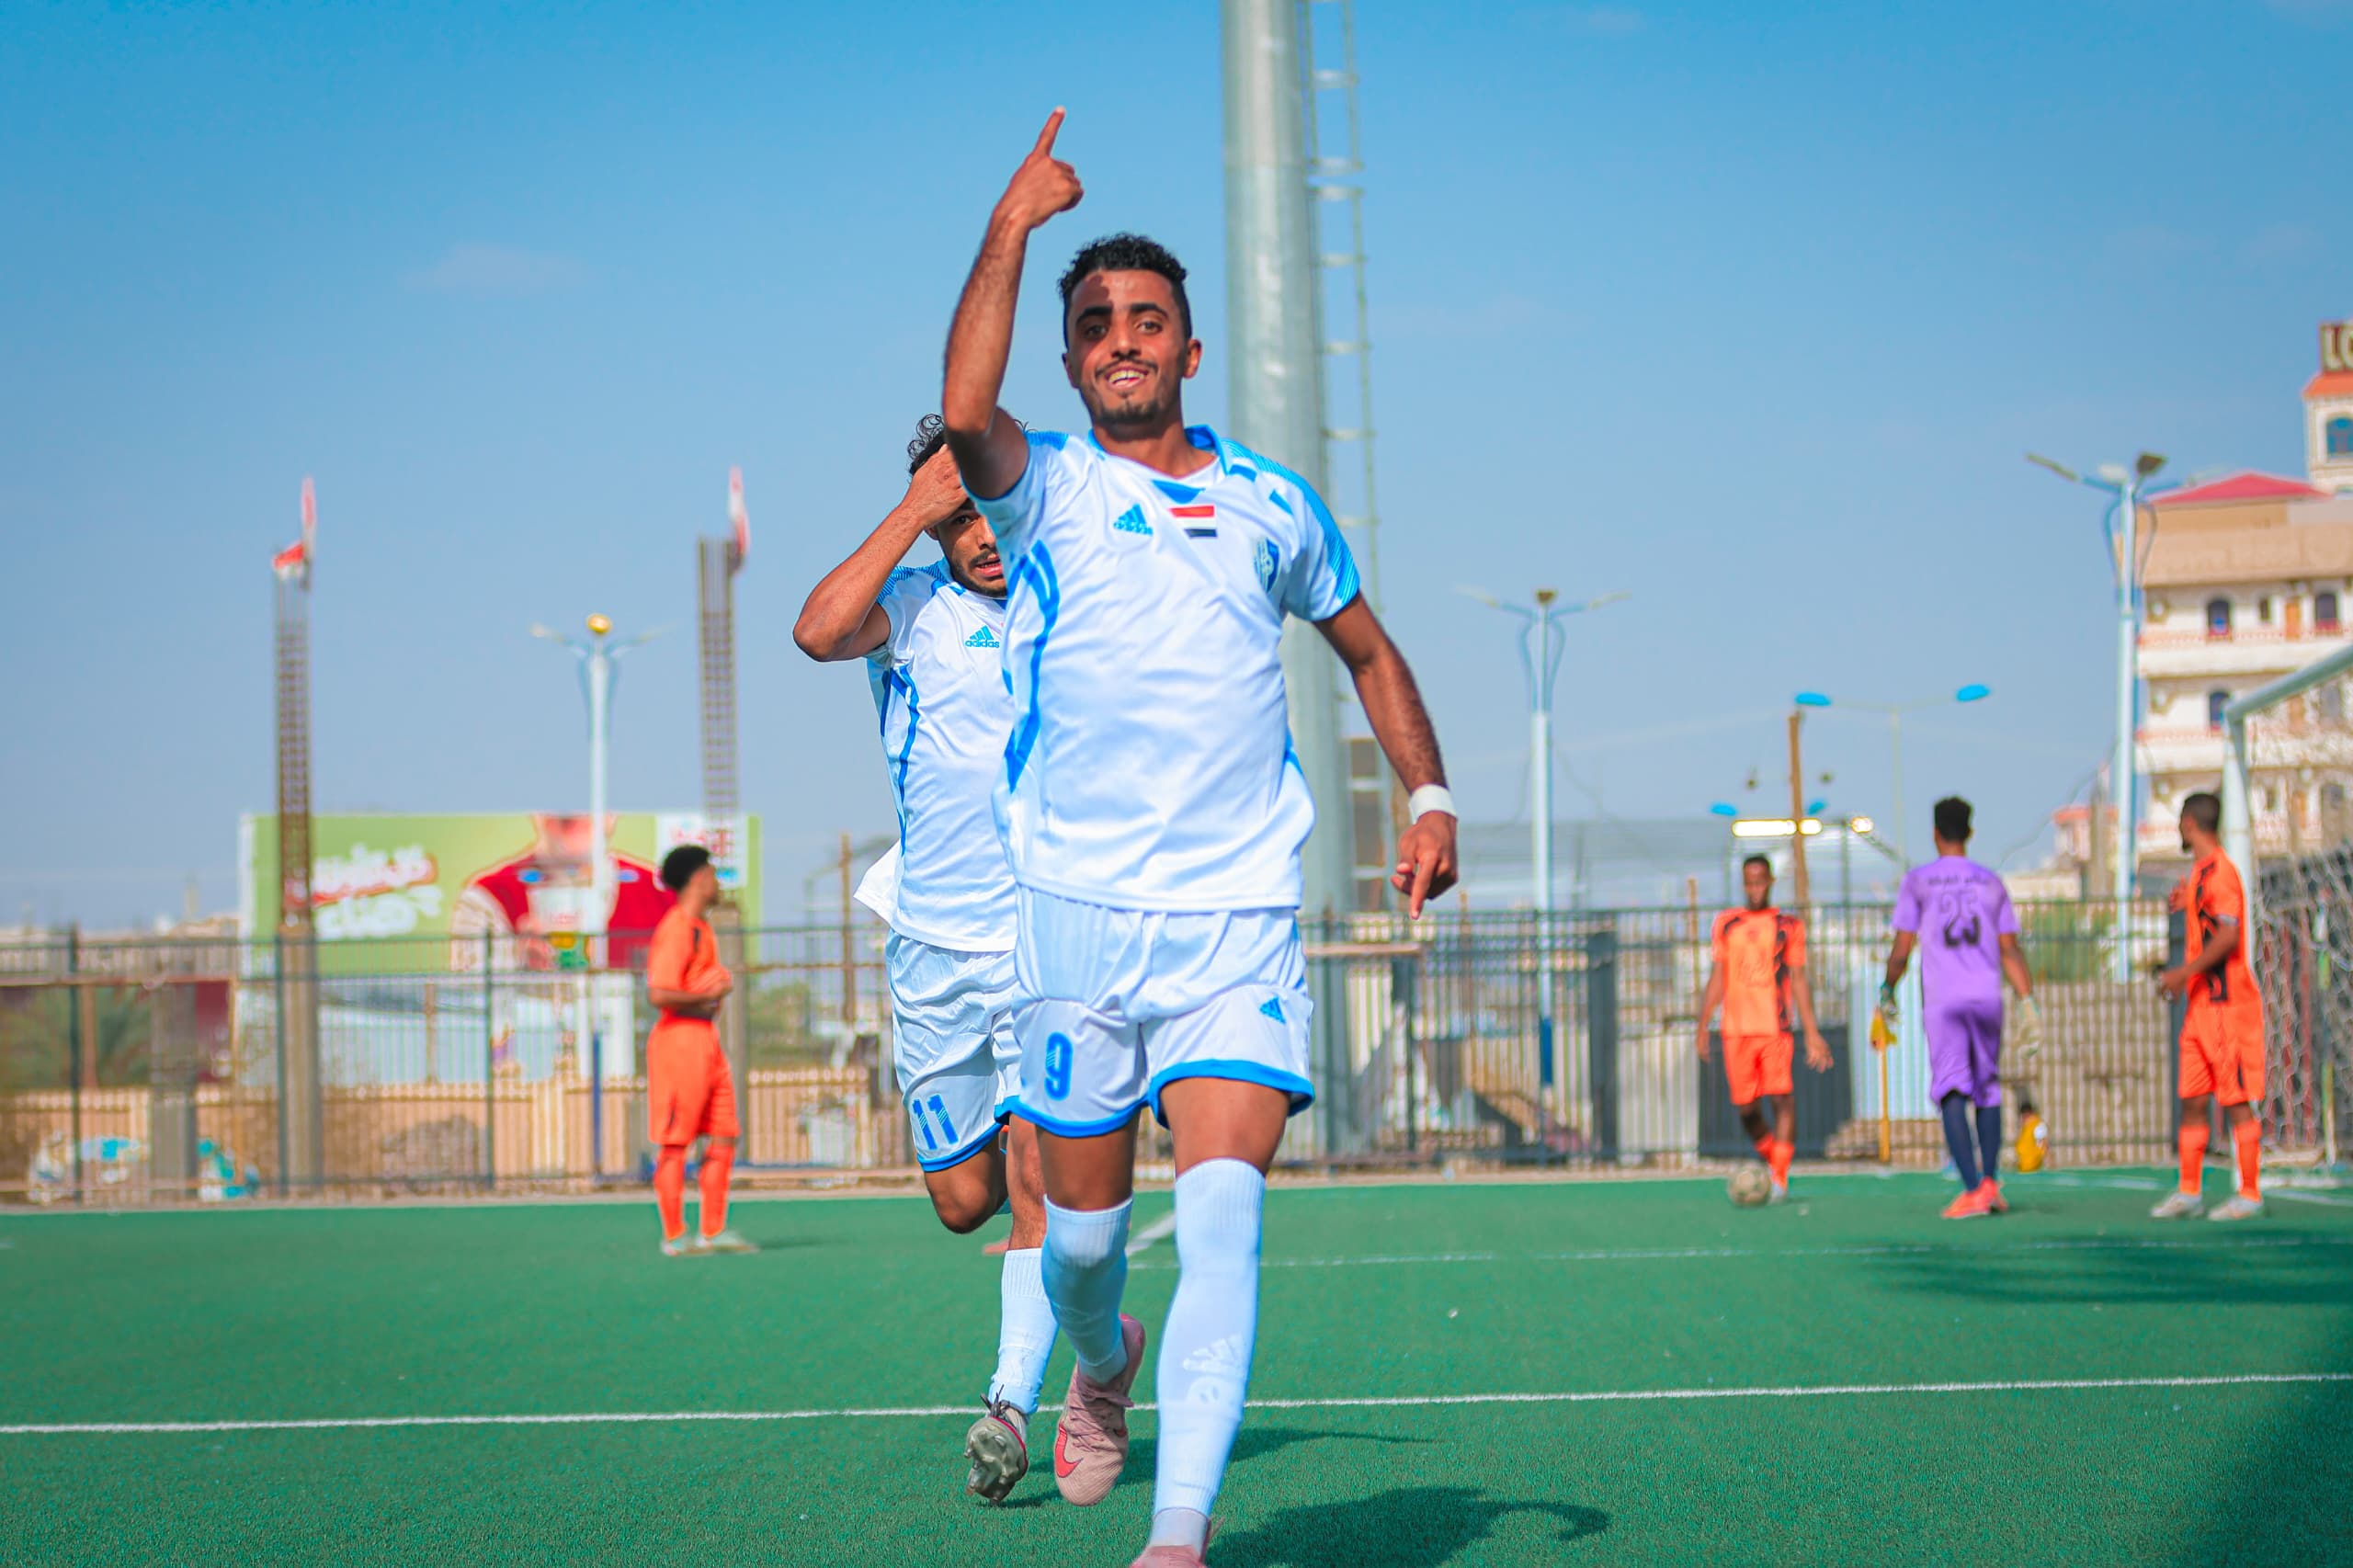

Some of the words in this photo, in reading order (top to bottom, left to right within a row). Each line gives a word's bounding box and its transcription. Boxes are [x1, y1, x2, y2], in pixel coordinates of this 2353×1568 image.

[965, 639, 1000, 649] adidas
[1044, 1030, 1074, 1102] 9
[911, 1093, 960, 1151] 11
